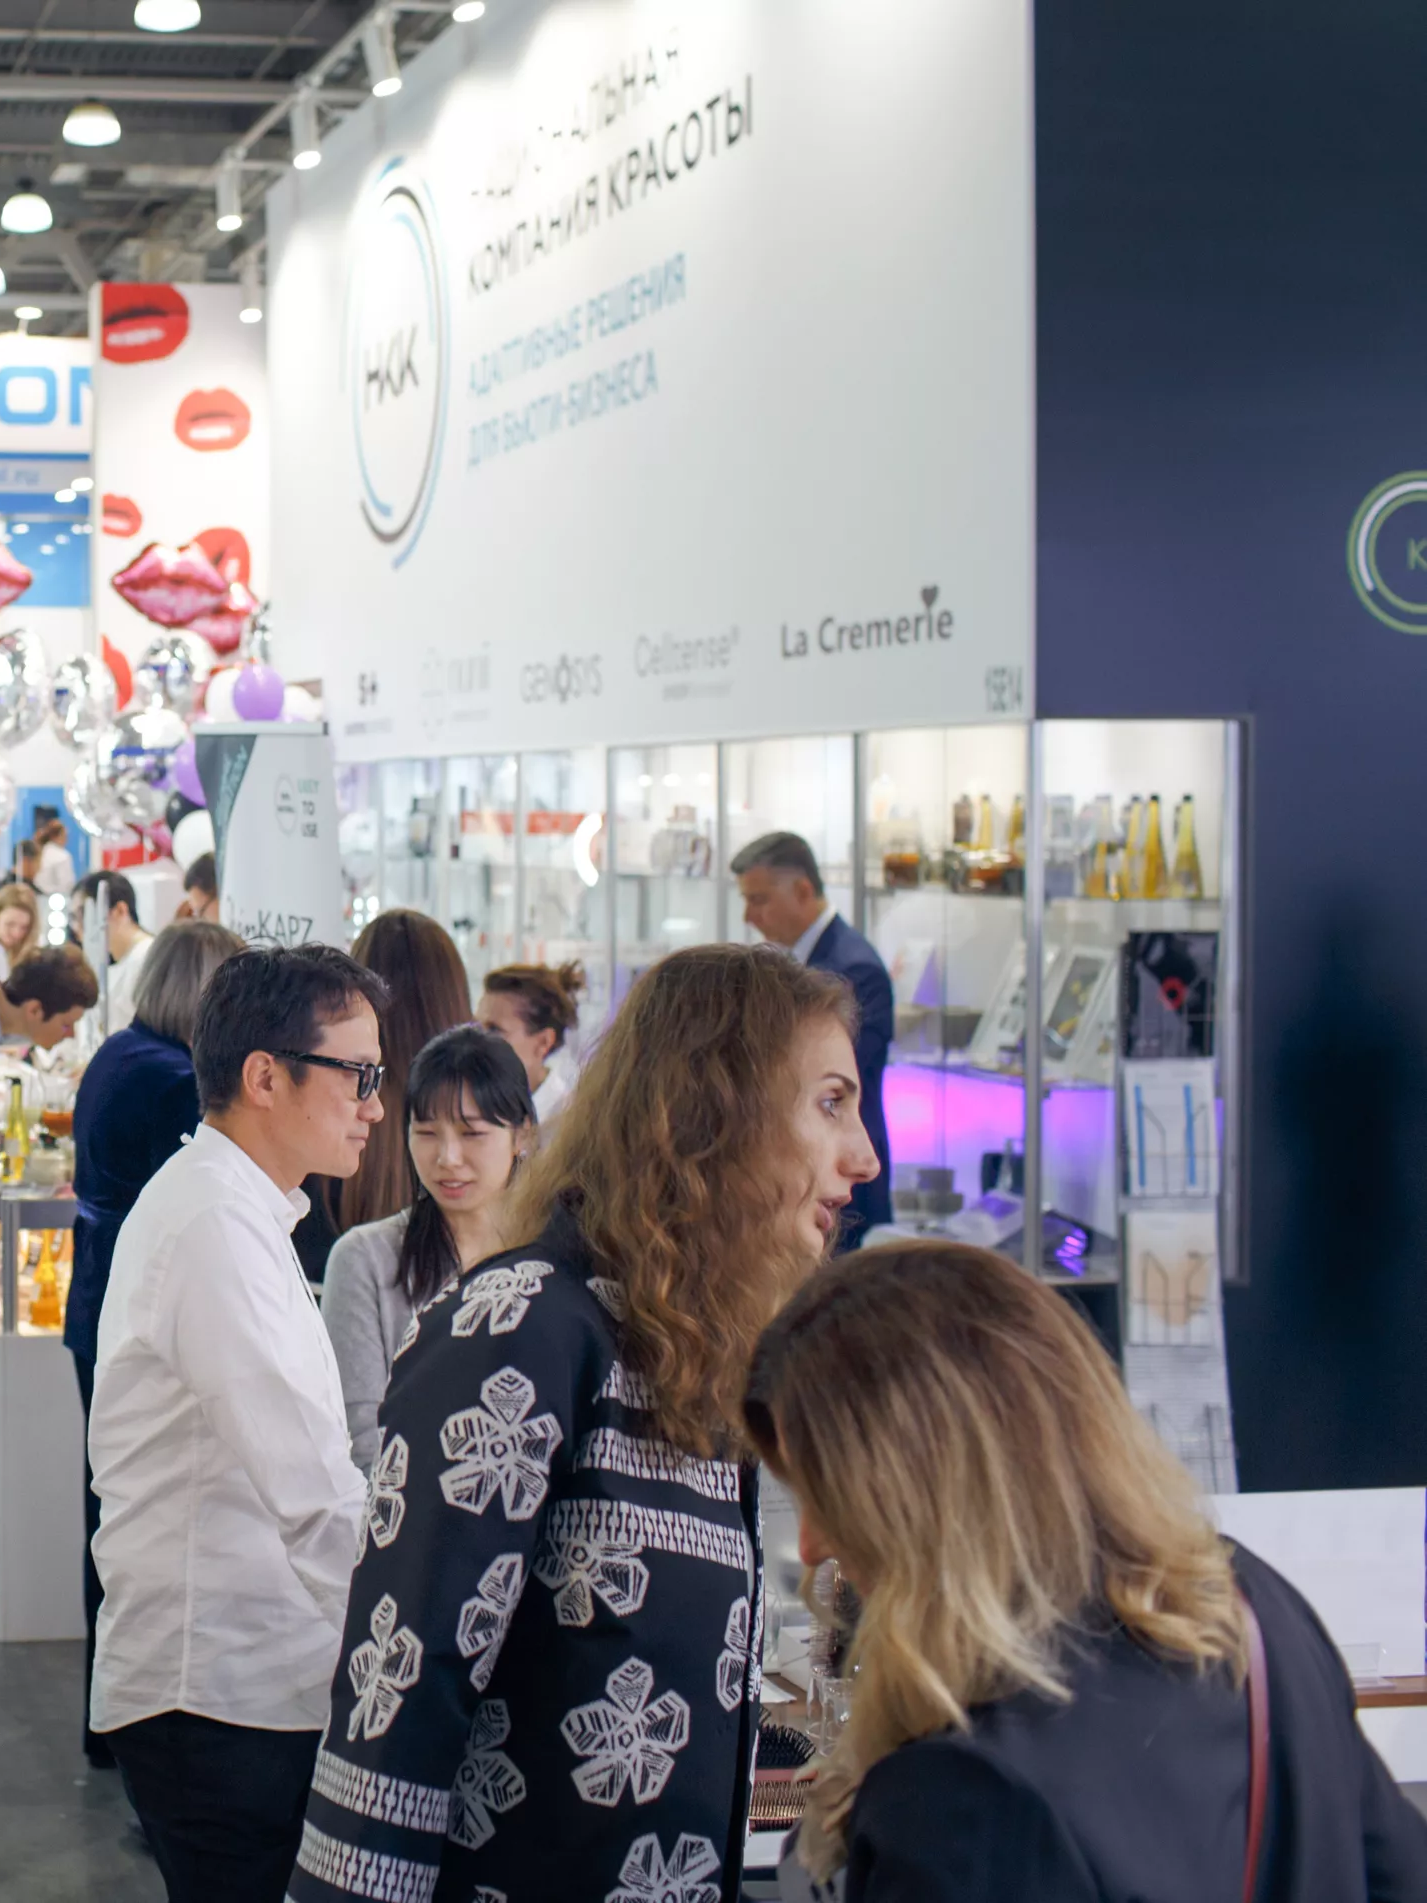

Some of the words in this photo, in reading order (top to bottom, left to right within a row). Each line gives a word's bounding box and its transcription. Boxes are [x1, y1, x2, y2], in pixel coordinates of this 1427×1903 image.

[607, 73, 753, 219] КРАСОТЫ
[781, 621, 809, 660] La
[818, 584, 954, 654] Cremerie
